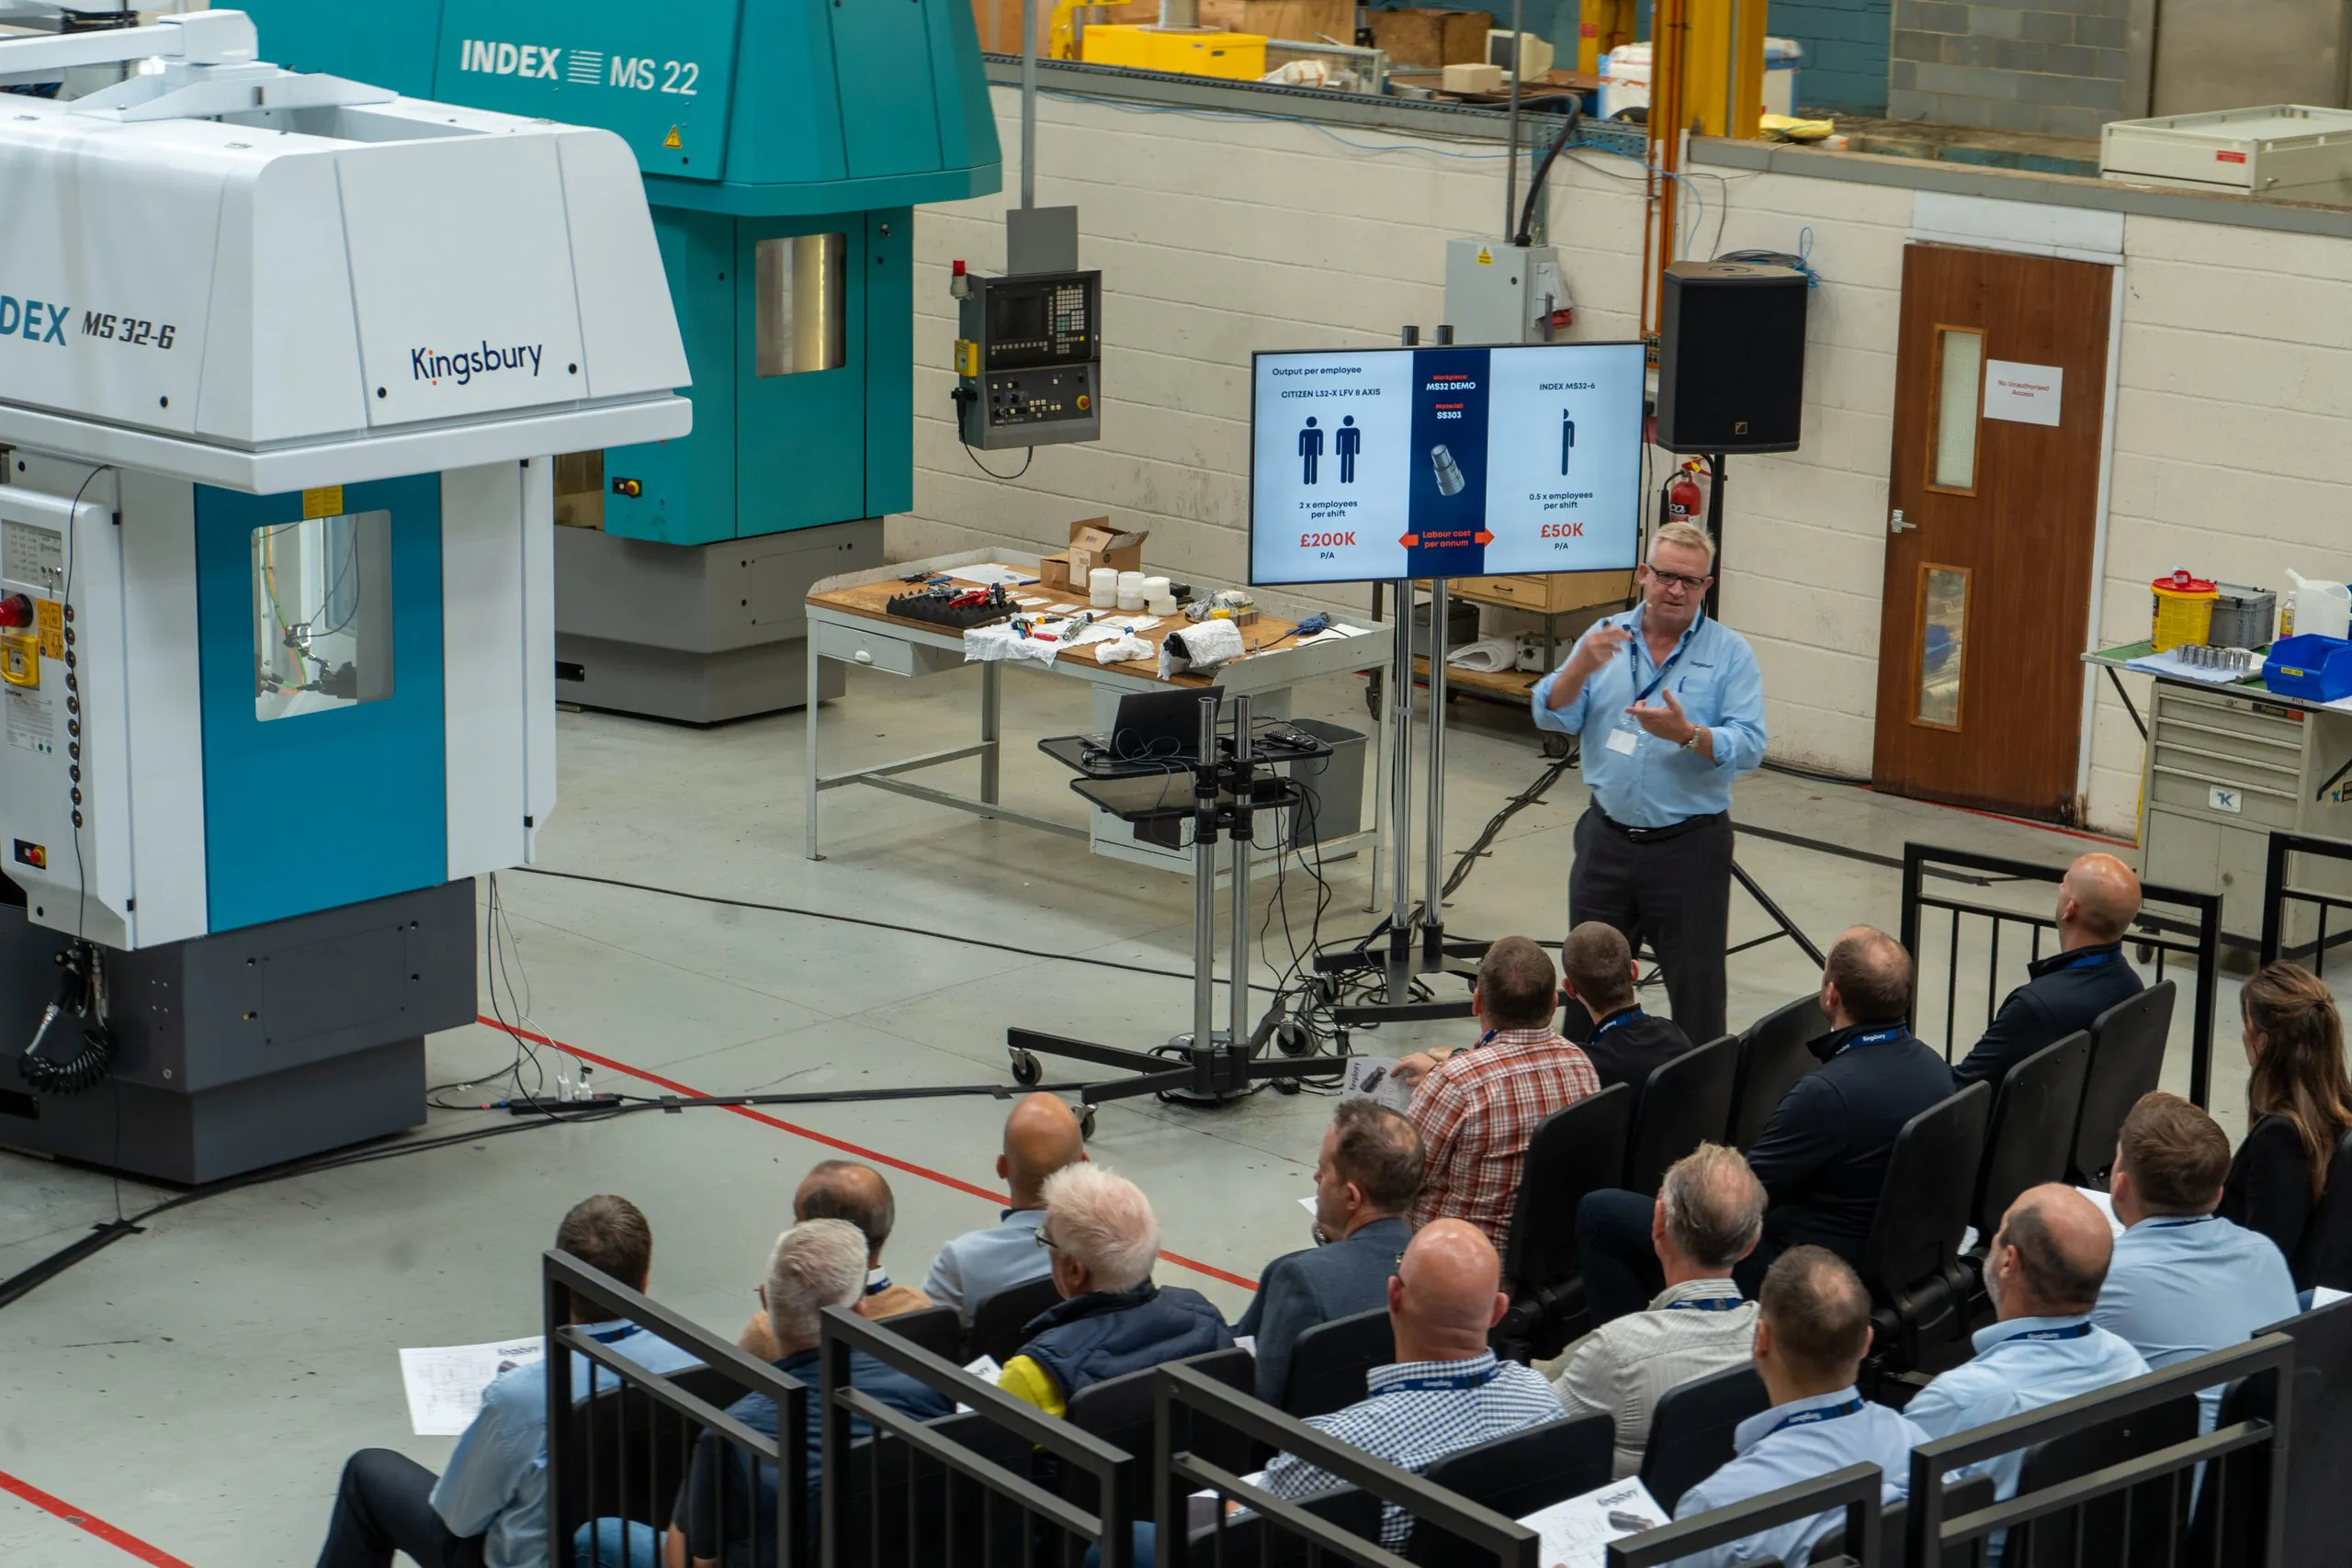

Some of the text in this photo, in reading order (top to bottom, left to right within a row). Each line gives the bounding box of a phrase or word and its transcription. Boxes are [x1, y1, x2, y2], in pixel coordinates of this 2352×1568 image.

[460, 39, 699, 96] INDEX MS 22
[82, 310, 118, 339] MS
[119, 318, 175, 350] 32-6
[411, 340, 543, 387] Kingsbury
[1272, 367, 1362, 377] Output per employee
[1426, 381, 1476, 390] MS32 DEMO
[1281, 389, 1314, 399] CITIZEN
[1315, 389, 1338, 398] L32-X
[1339, 389, 1353, 397] LFV
[1362, 388, 1381, 396] AXIS
[1548, 491, 1594, 501] employees
[1312, 501, 1358, 510] employees
[1544, 502, 1558, 511] per
[1311, 511, 1325, 520] per
[1422, 529, 1471, 538] Labour cost
[1541, 522, 1585, 538] £50K
[1300, 531, 1356, 547] £200K
[1424, 539, 1469, 549] per annum
[1554, 542, 1569, 550] P/A
[1320, 551, 1335, 559] P/A
[1862, 1033, 1886, 1043] Kingsbury
